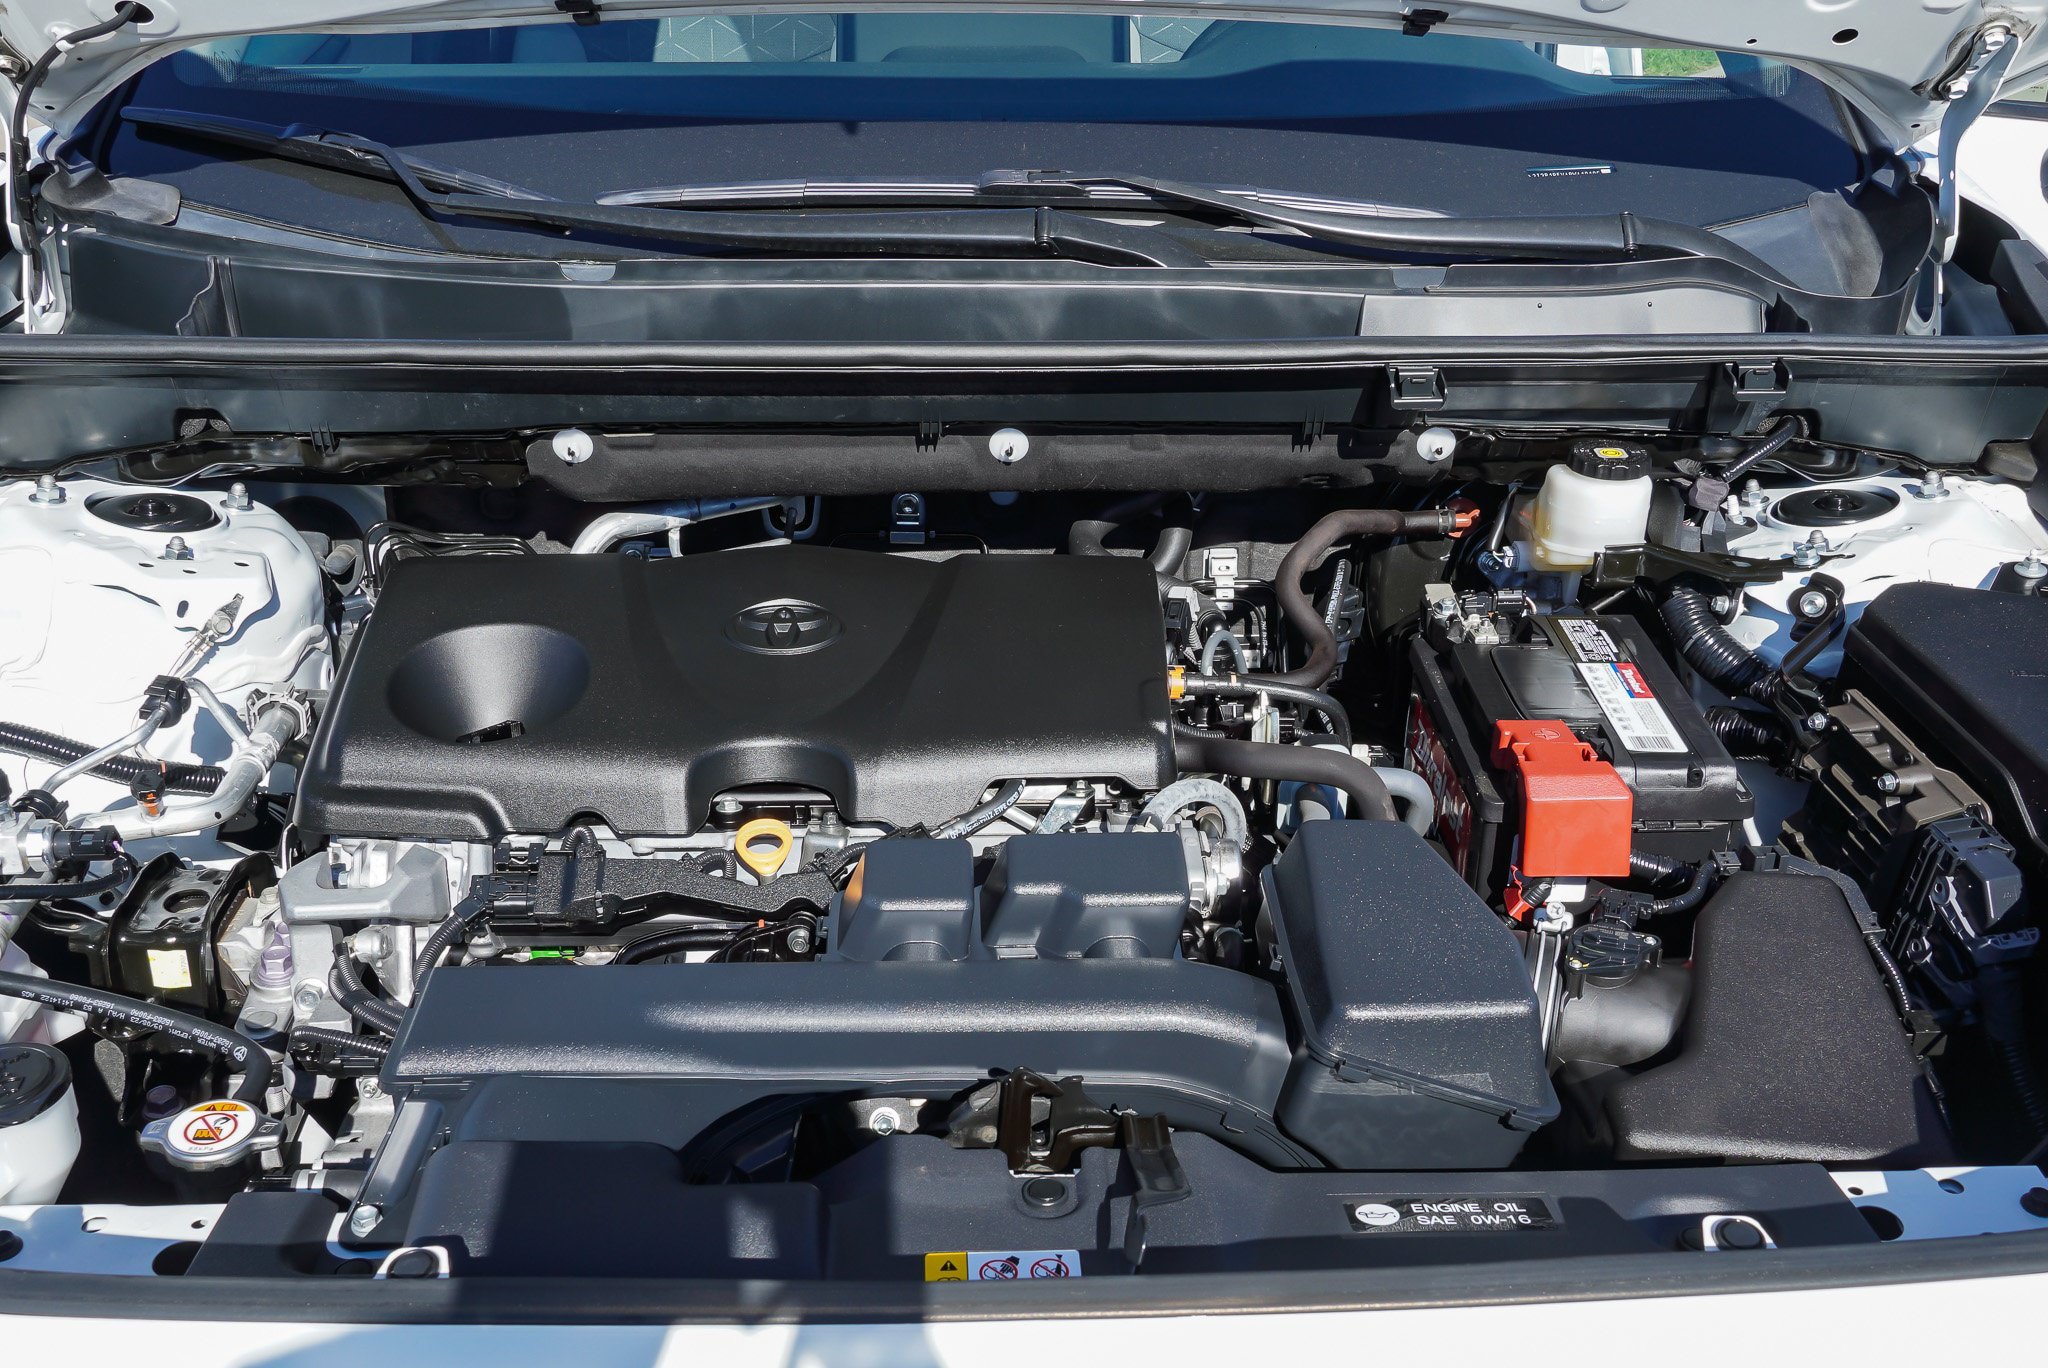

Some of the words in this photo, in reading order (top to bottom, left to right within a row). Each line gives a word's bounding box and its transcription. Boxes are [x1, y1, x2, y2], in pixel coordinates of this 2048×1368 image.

[1410, 1203, 1483, 1213] ENGINE
[1493, 1202, 1527, 1212] OIL
[1417, 1215, 1458, 1225] SAE
[1470, 1214, 1532, 1225] 0W-16
